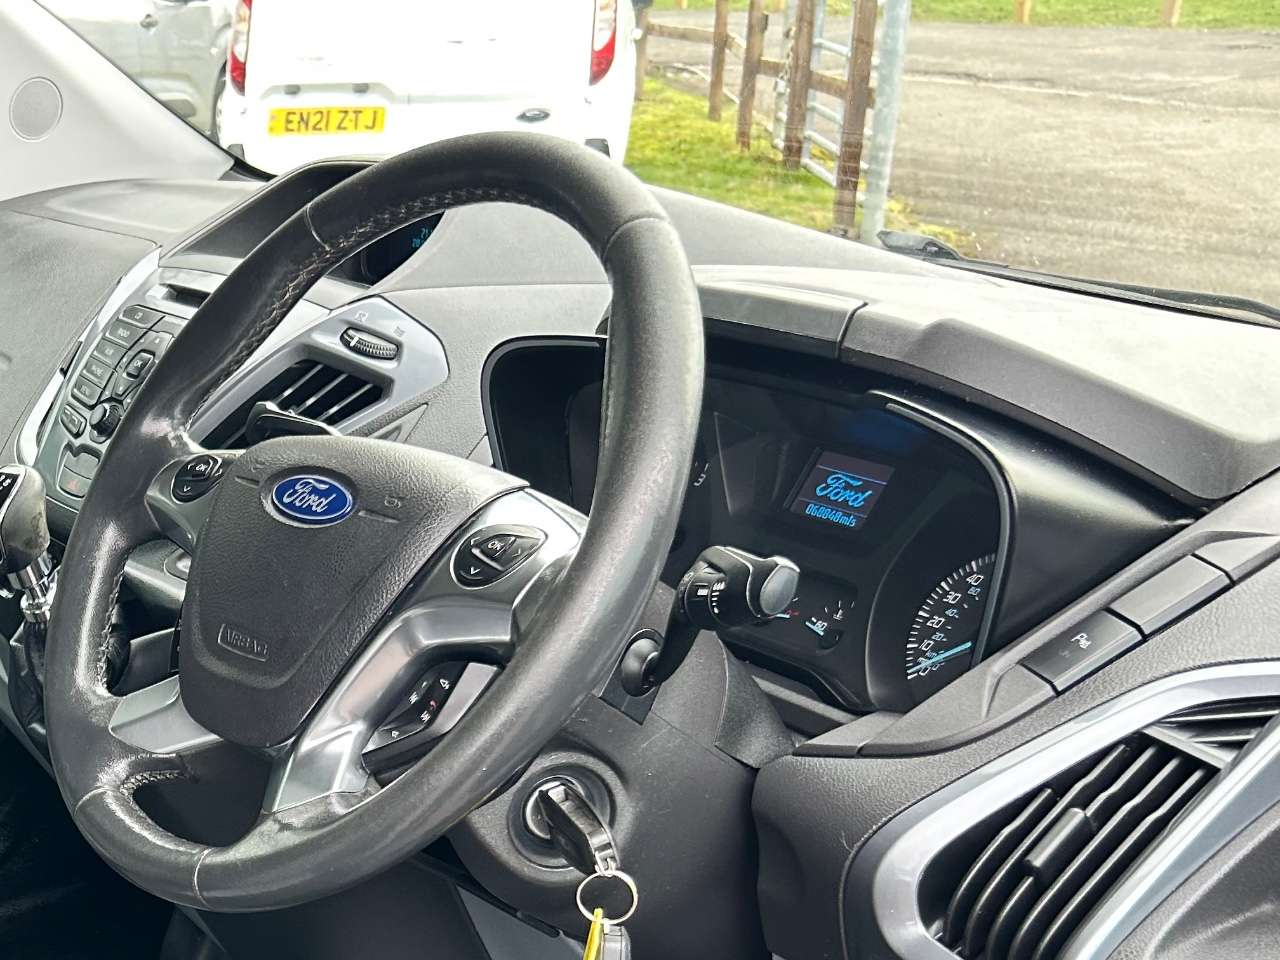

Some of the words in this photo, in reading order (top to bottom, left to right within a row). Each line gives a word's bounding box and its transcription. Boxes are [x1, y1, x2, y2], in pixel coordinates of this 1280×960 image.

[285, 110, 330, 132] EN21
[336, 110, 379, 131] ZTJ
[283, 479, 336, 513] Ford
[816, 474, 872, 507] Ford
[487, 540, 504, 551] OK
[966, 574, 984, 586] 40
[942, 591, 962, 604] 30
[926, 615, 945, 628] 20
[931, 632, 945, 640] 20
[919, 639, 935, 651] 10
